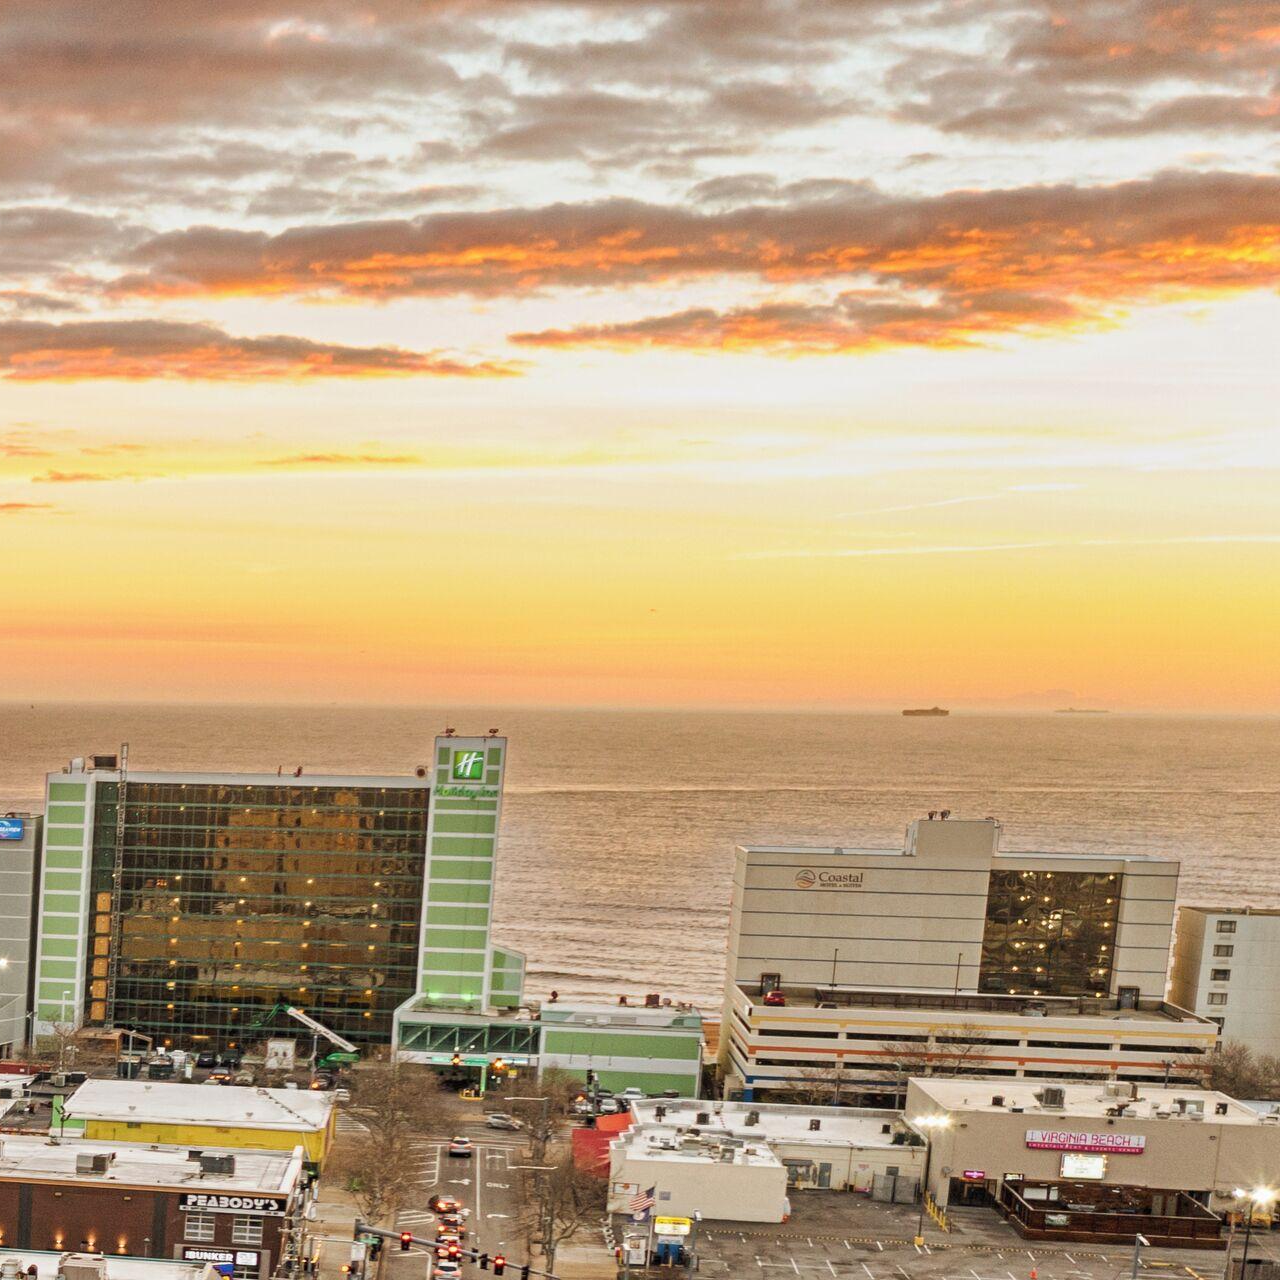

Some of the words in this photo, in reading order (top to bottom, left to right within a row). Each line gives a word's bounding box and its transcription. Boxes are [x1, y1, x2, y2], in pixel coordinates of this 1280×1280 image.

[819, 871, 863, 883] Coastal
[1041, 1131, 1087, 1144] VIRGINIA
[1091, 1134, 1131, 1146] BEACH
[187, 1194, 279, 1211] PEABODY'S
[189, 1250, 234, 1262] BUNKER
